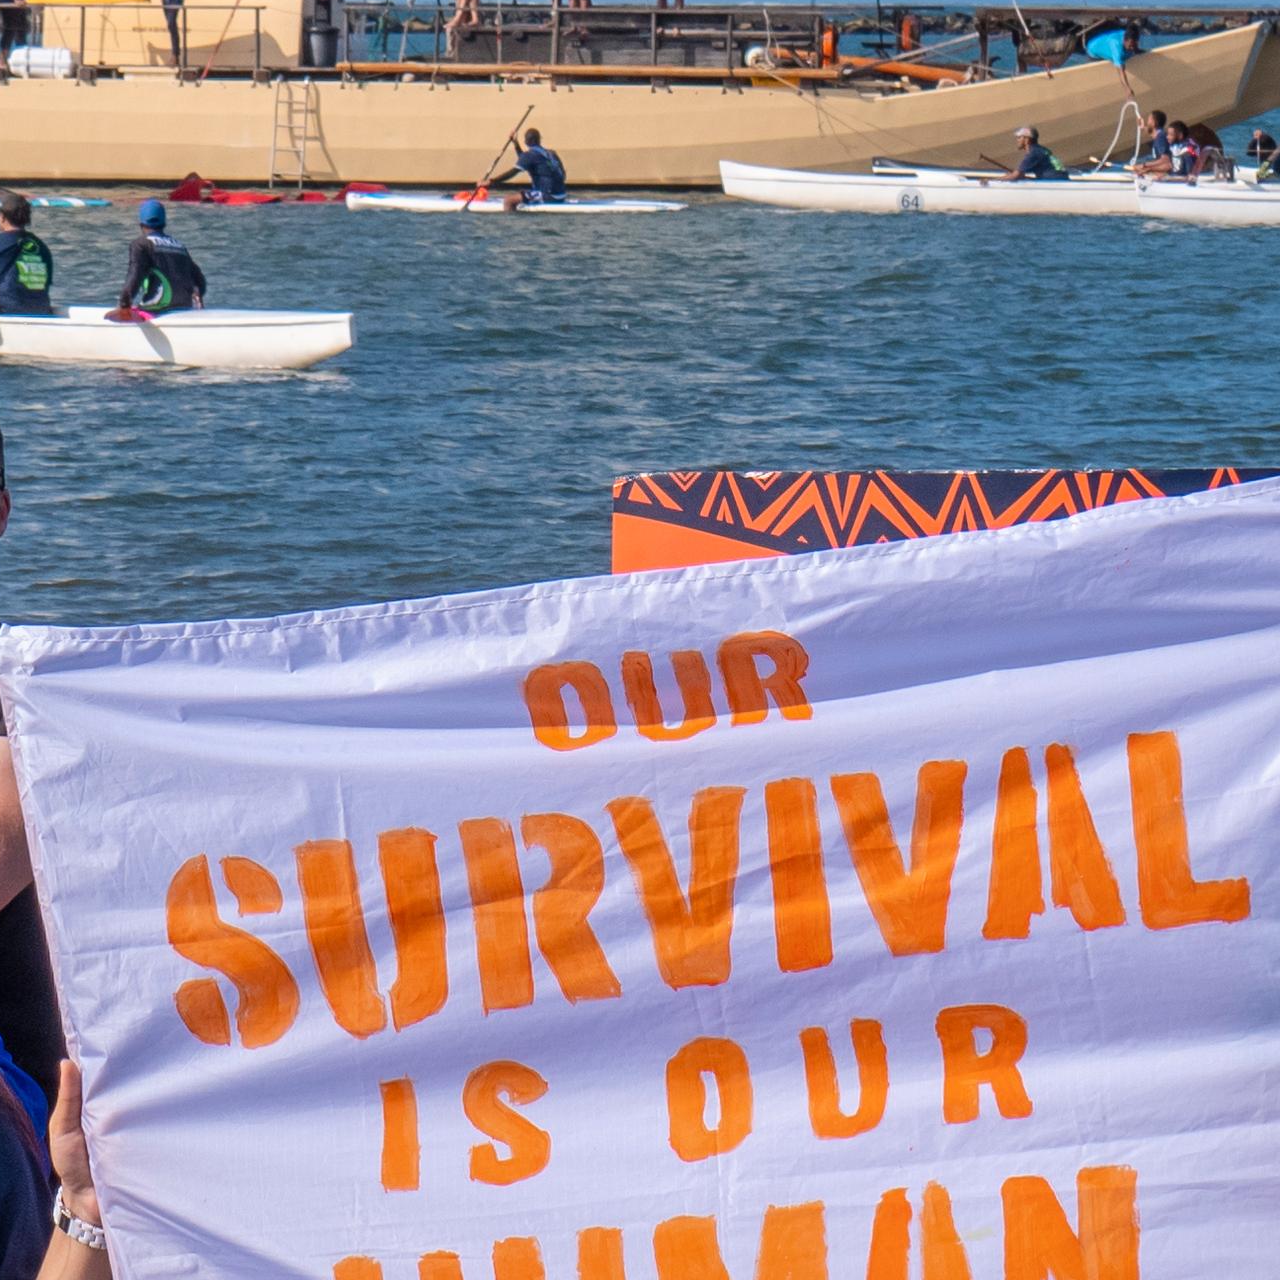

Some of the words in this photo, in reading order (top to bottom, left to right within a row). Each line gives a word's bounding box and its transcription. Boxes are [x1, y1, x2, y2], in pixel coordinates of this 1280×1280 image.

[901, 193, 919, 209] 64
[522, 631, 814, 752] OUR
[166, 730, 1252, 1049] SURVIVAL
[380, 1060, 552, 1193] IS
[665, 1003, 1033, 1162] OUR
